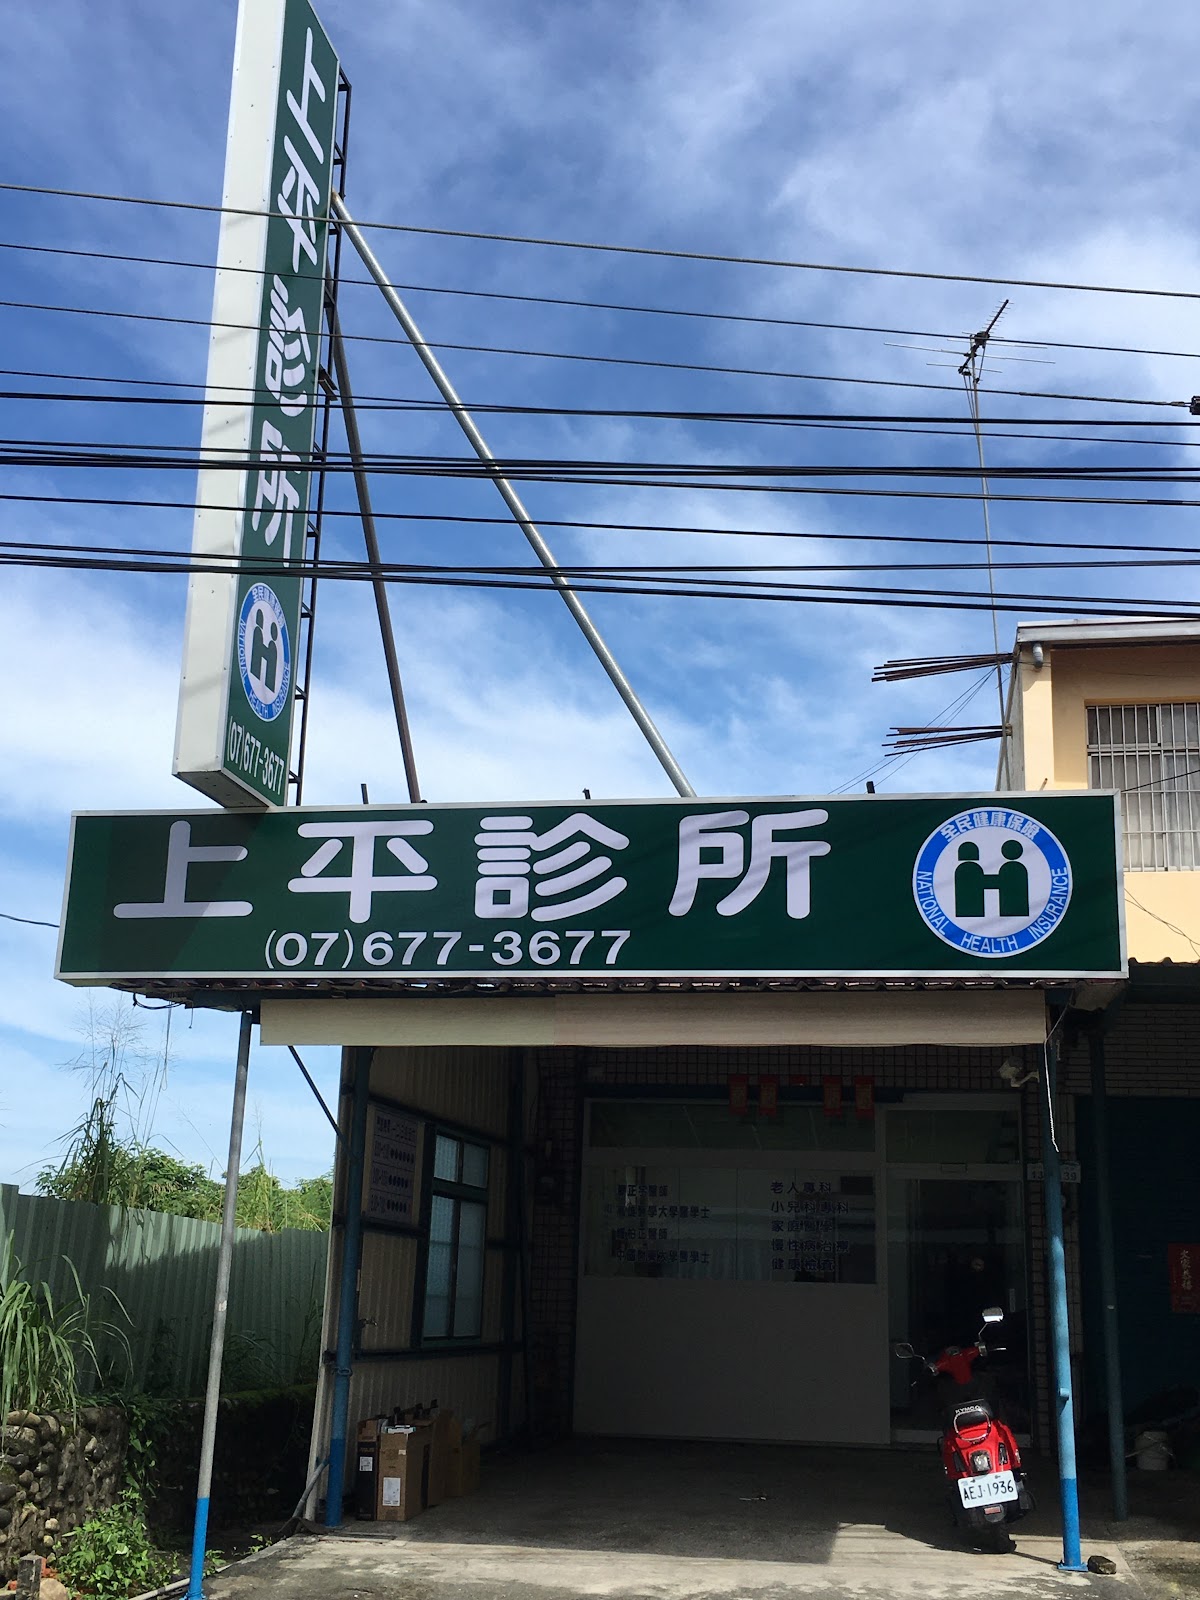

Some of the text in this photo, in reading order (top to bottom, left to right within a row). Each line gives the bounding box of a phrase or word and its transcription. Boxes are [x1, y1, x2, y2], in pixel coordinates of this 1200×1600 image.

[251, 26, 326, 568] 上平診所
[238, 619, 248, 686] NATIONAL
[227, 716, 285, 796] (07)677-3677
[113, 808, 831, 924] 上平診所
[940, 811, 1040, 842] 全民健康保險
[264, 929, 631, 969] (07)677-3677
[916, 866, 1069, 953] NATIONAL HEALTH INSURANCE
